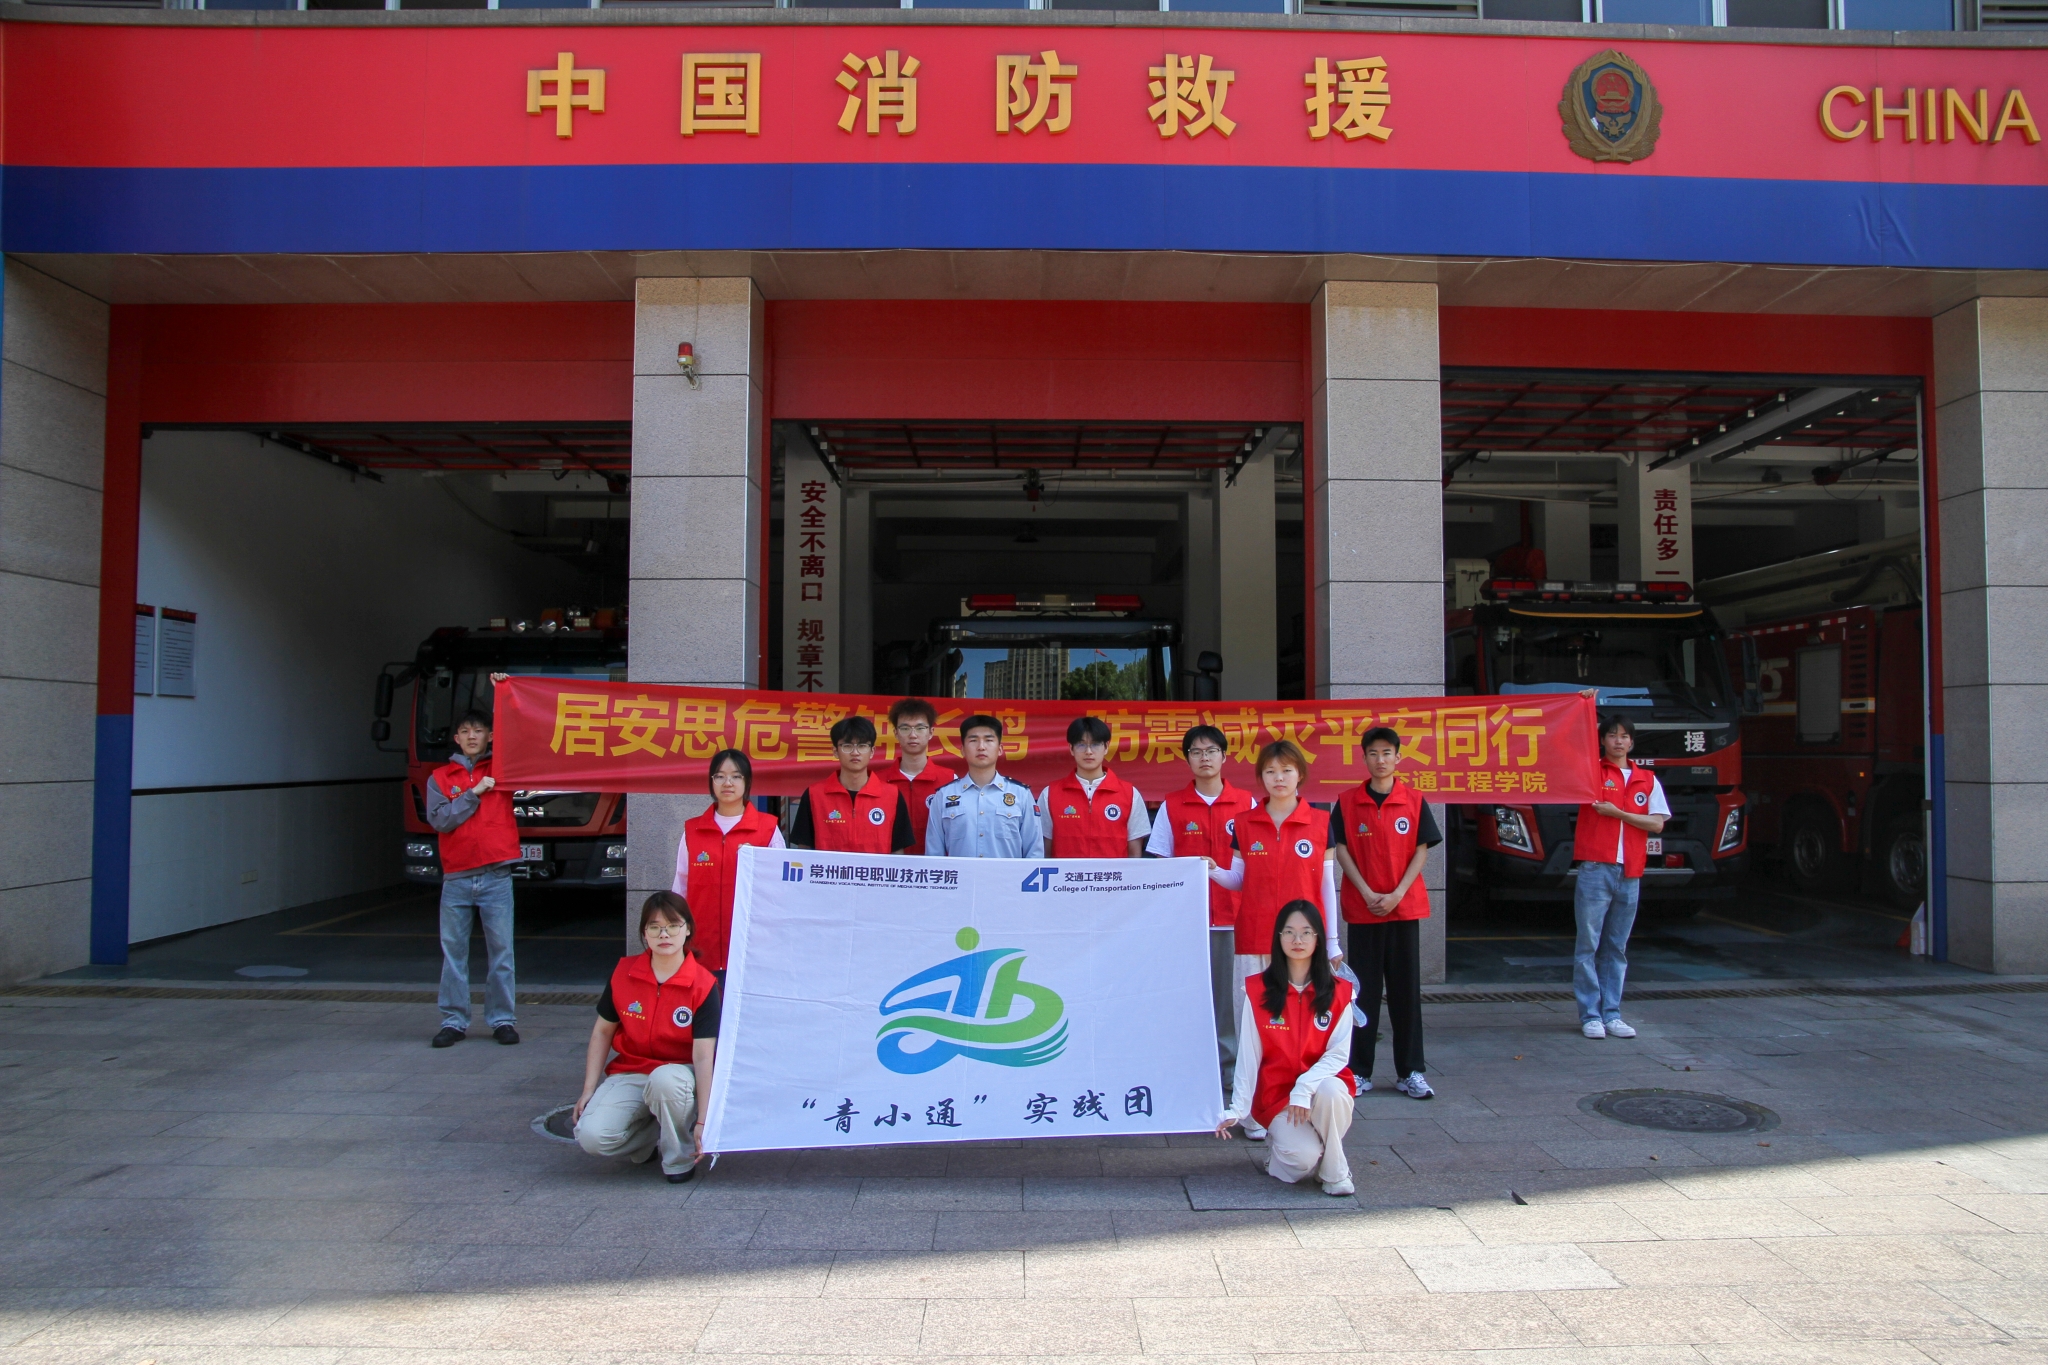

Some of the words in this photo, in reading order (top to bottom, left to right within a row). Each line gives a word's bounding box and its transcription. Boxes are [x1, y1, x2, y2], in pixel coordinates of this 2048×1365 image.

[526, 51, 1393, 142] 中国消防救援
[1819, 84, 2043, 145] CHINA
[799, 480, 827, 602] 安全不离口
[1653, 488, 1680, 575] 责任多一
[1684, 731, 1706, 752] 援
[513, 806, 544, 817] AN
[810, 863, 959, 885] 常州机电职业技术学院
[1064, 871, 1123, 882] 交通工程学院
[1052, 885, 1079, 893] College
[1089, 884, 1141, 892] Transportation
[1142, 881, 1184, 891] Engineering
